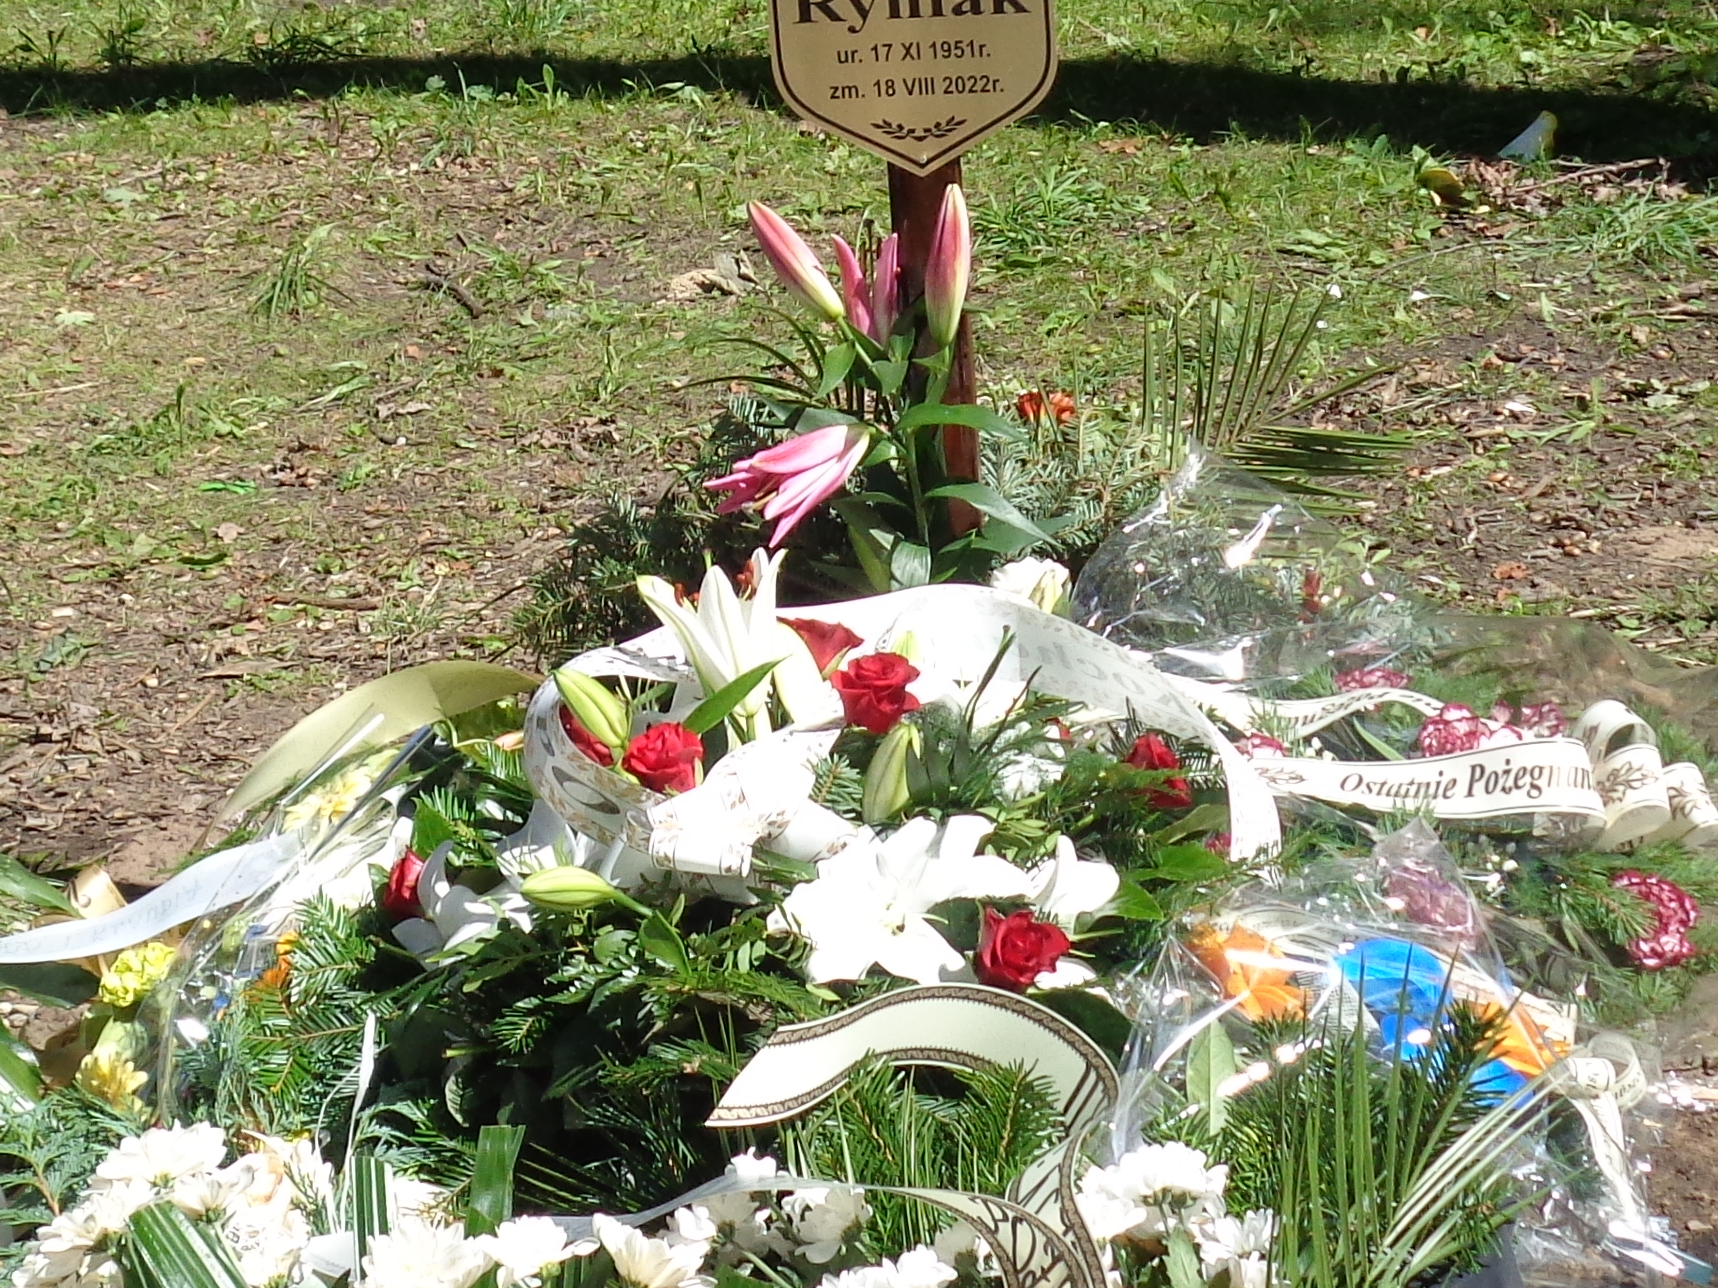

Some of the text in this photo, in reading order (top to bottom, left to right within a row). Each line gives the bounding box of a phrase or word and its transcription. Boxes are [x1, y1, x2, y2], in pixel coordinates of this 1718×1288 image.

[837, 39, 992, 64] ur. 17 XI 1951r.
[829, 74, 1005, 100] zm. 18 VIII 2022r.
[1339, 769, 1457, 800] Ostatnie
